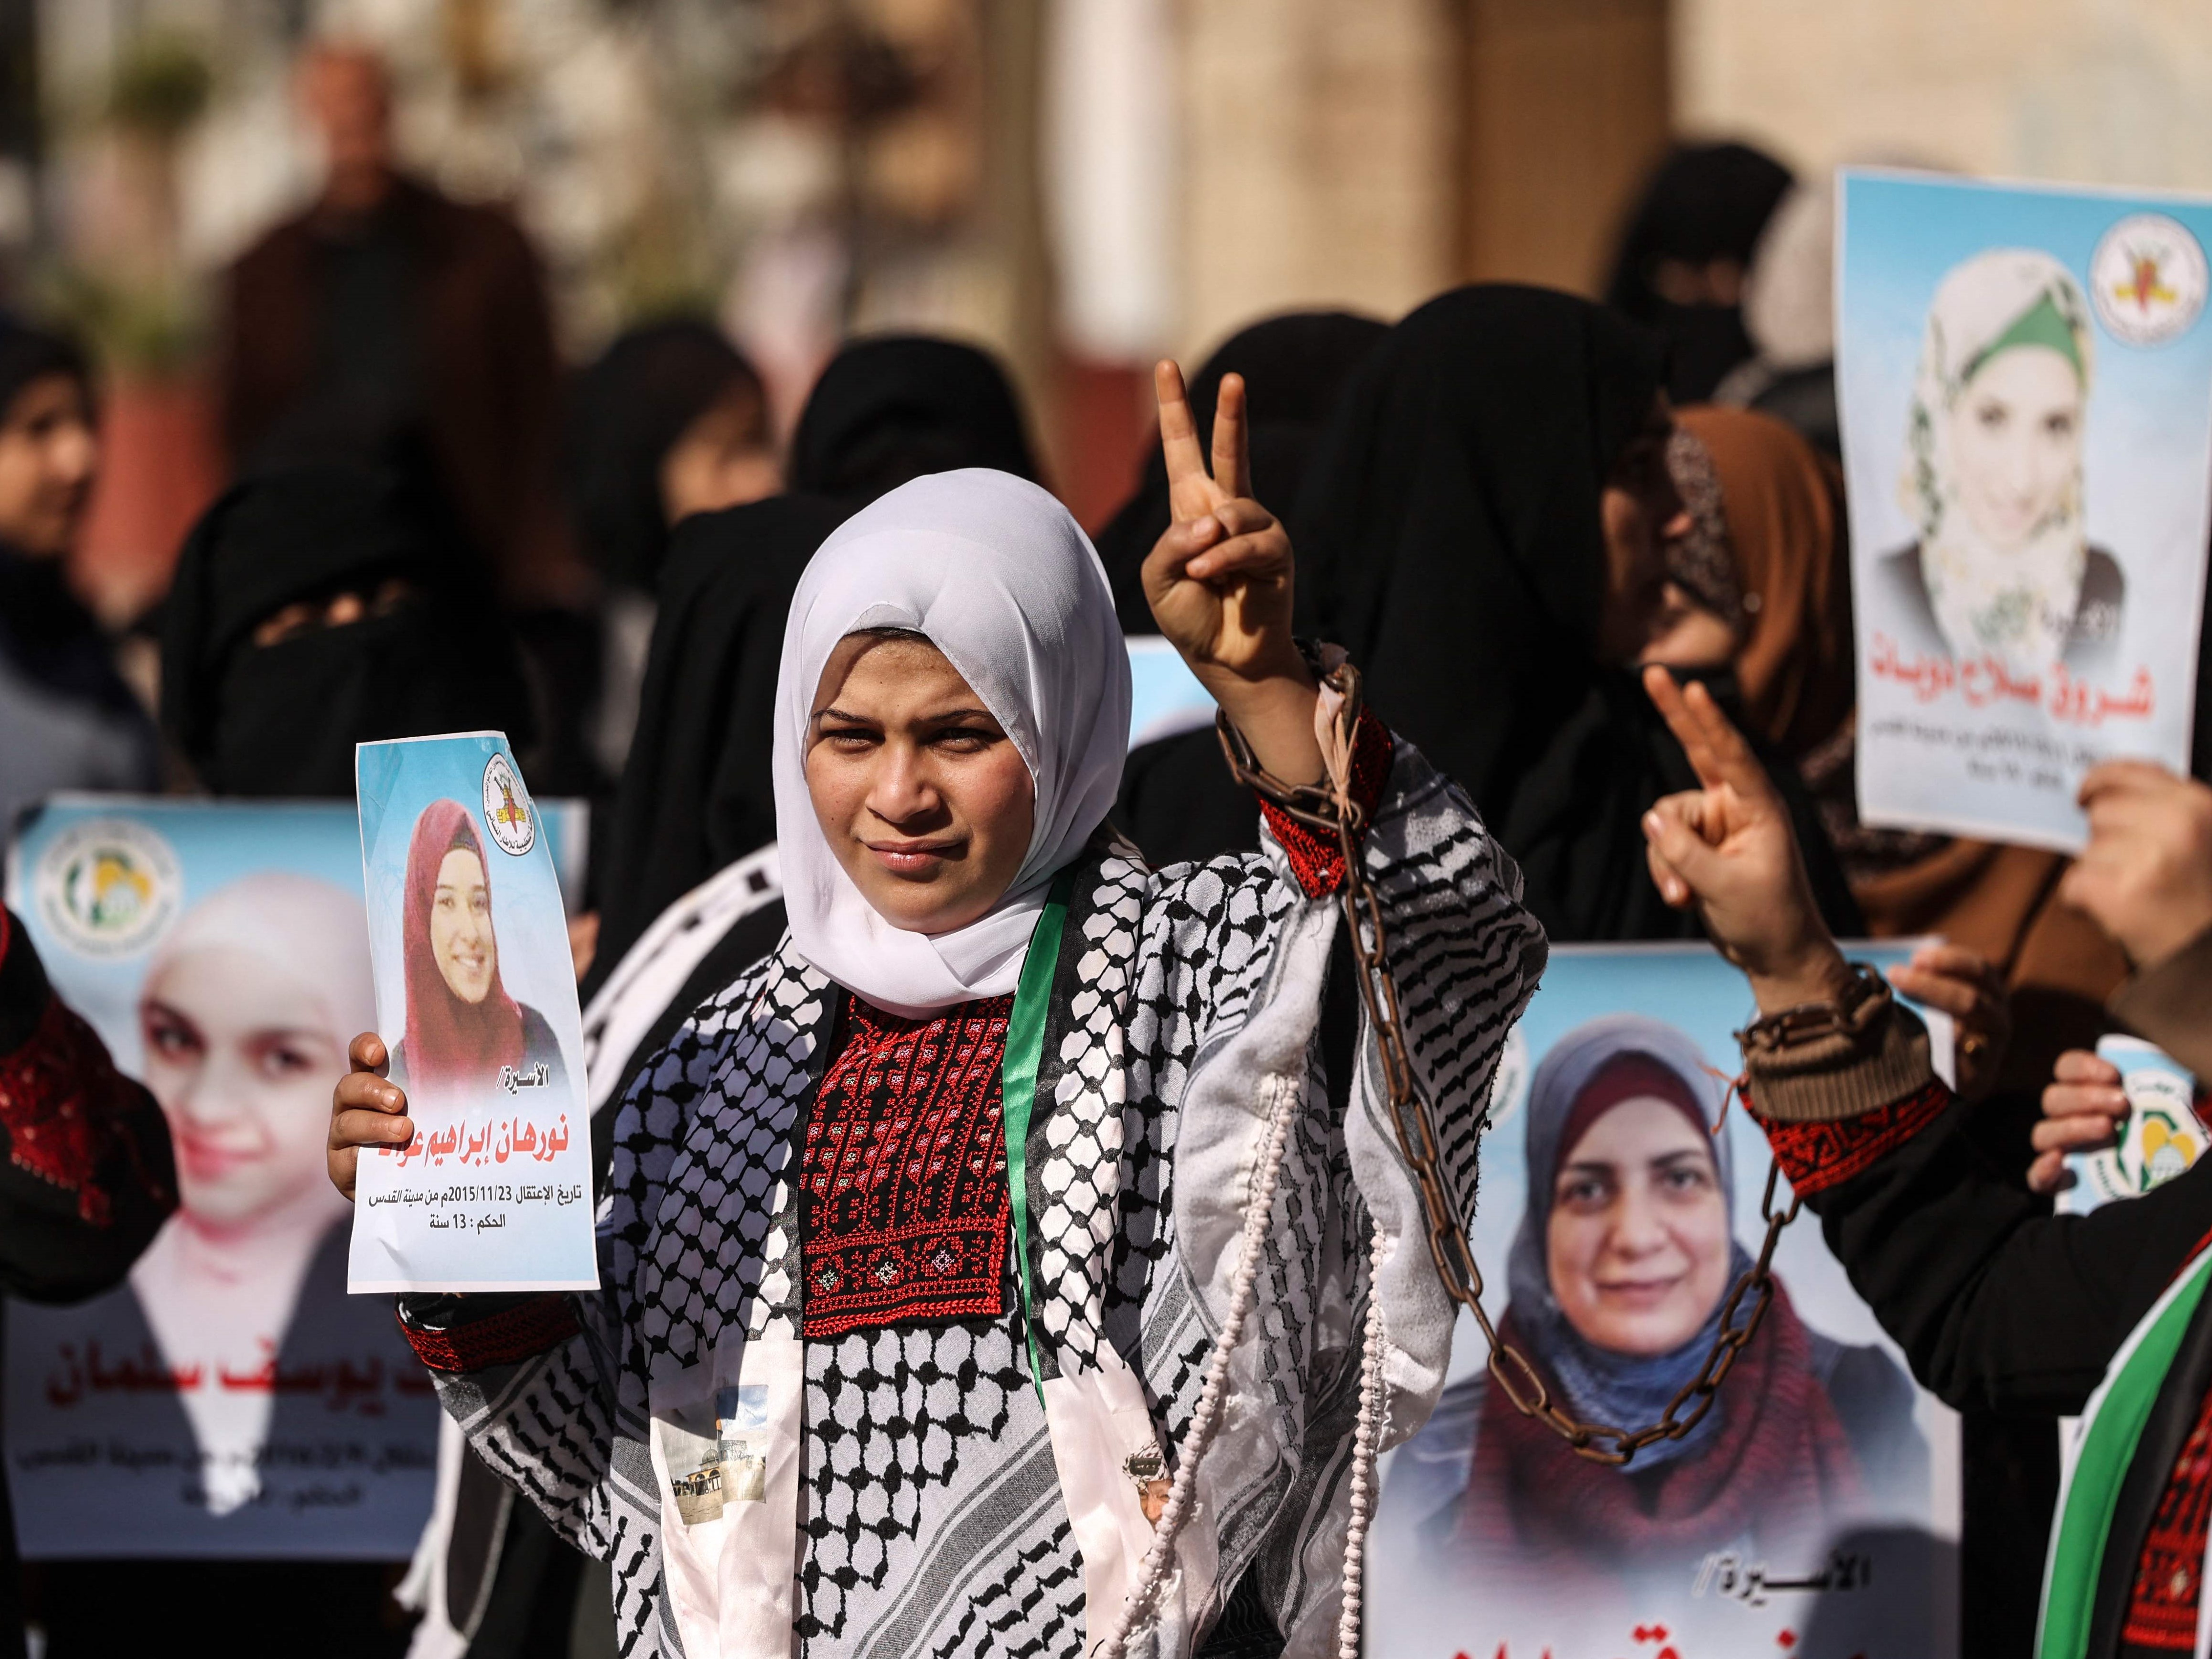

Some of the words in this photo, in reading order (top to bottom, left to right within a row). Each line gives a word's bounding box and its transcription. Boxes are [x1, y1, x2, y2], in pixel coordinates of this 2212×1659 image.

[424, 1117, 492, 1167] إبراهيم
[495, 1113, 569, 1164] نورهان
[368, 1190, 402, 1207] القدس
[403, 1189, 423, 1207] مدينة
[425, 1189, 439, 1206] من
[516, 1185, 553, 1206] الإعتقال
[557, 1184, 581, 1207] تاريخ
[430, 1214, 449, 1228] سنة
[453, 1214, 466, 1229] 13
[477, 1214, 505, 1235] الحكم
